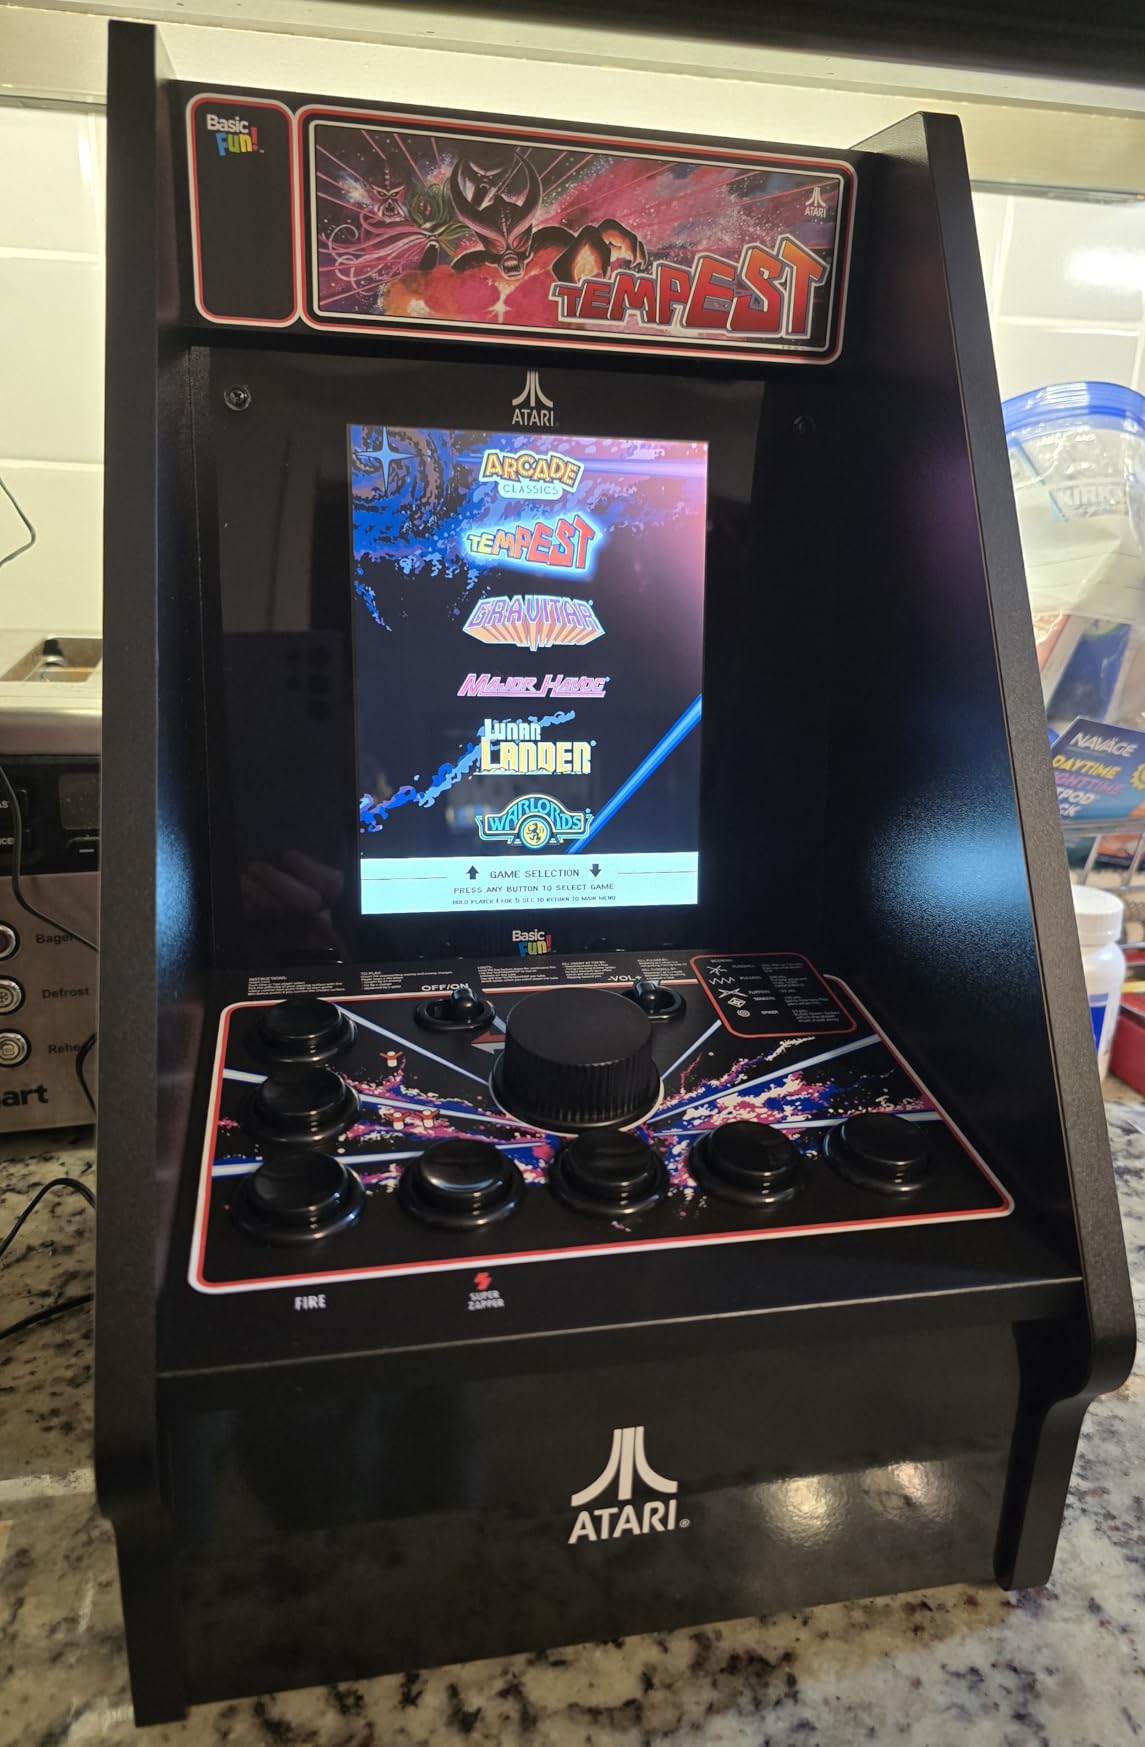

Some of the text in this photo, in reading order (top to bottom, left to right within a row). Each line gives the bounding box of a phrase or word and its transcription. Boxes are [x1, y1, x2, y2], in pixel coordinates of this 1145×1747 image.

[206, 113, 249, 134] Basic
[215, 127, 260, 156] Fun!
[804, 206, 827, 218] ATARI
[549, 234, 829, 339] TEMPEST
[512, 408, 554, 427] ATARI
[481, 450, 584, 491] ARCADE
[502, 483, 560, 496] CLASSICS
[466, 514, 597, 570] TEMPEST
[463, 594, 605, 645] GRAVITAR
[457, 673, 607, 698] MAJOR HAVOC
[483, 719, 541, 741] LUNAR
[480, 741, 592, 775] LANDER
[488, 797, 584, 831] WARLORDS
[489, 868, 580, 879] GAME SELECTION
[506, 885, 539, 893] BUTTON
[512, 929, 545, 942] Basic
[517, 934, 552, 957] Fun!
[42, 987, 89, 999] Defrost
[421, 983, 469, 992] OFF/ON
[48, 1042, 81, 1054] Rehe
[1, 1085, 49, 1107] art
[294, 1294, 327, 1311] FIRE
[467, 1298, 505, 1311] ZAPPER
[468, 1290, 500, 1301] SUPER
[568, 1499, 677, 1544] ATARI
